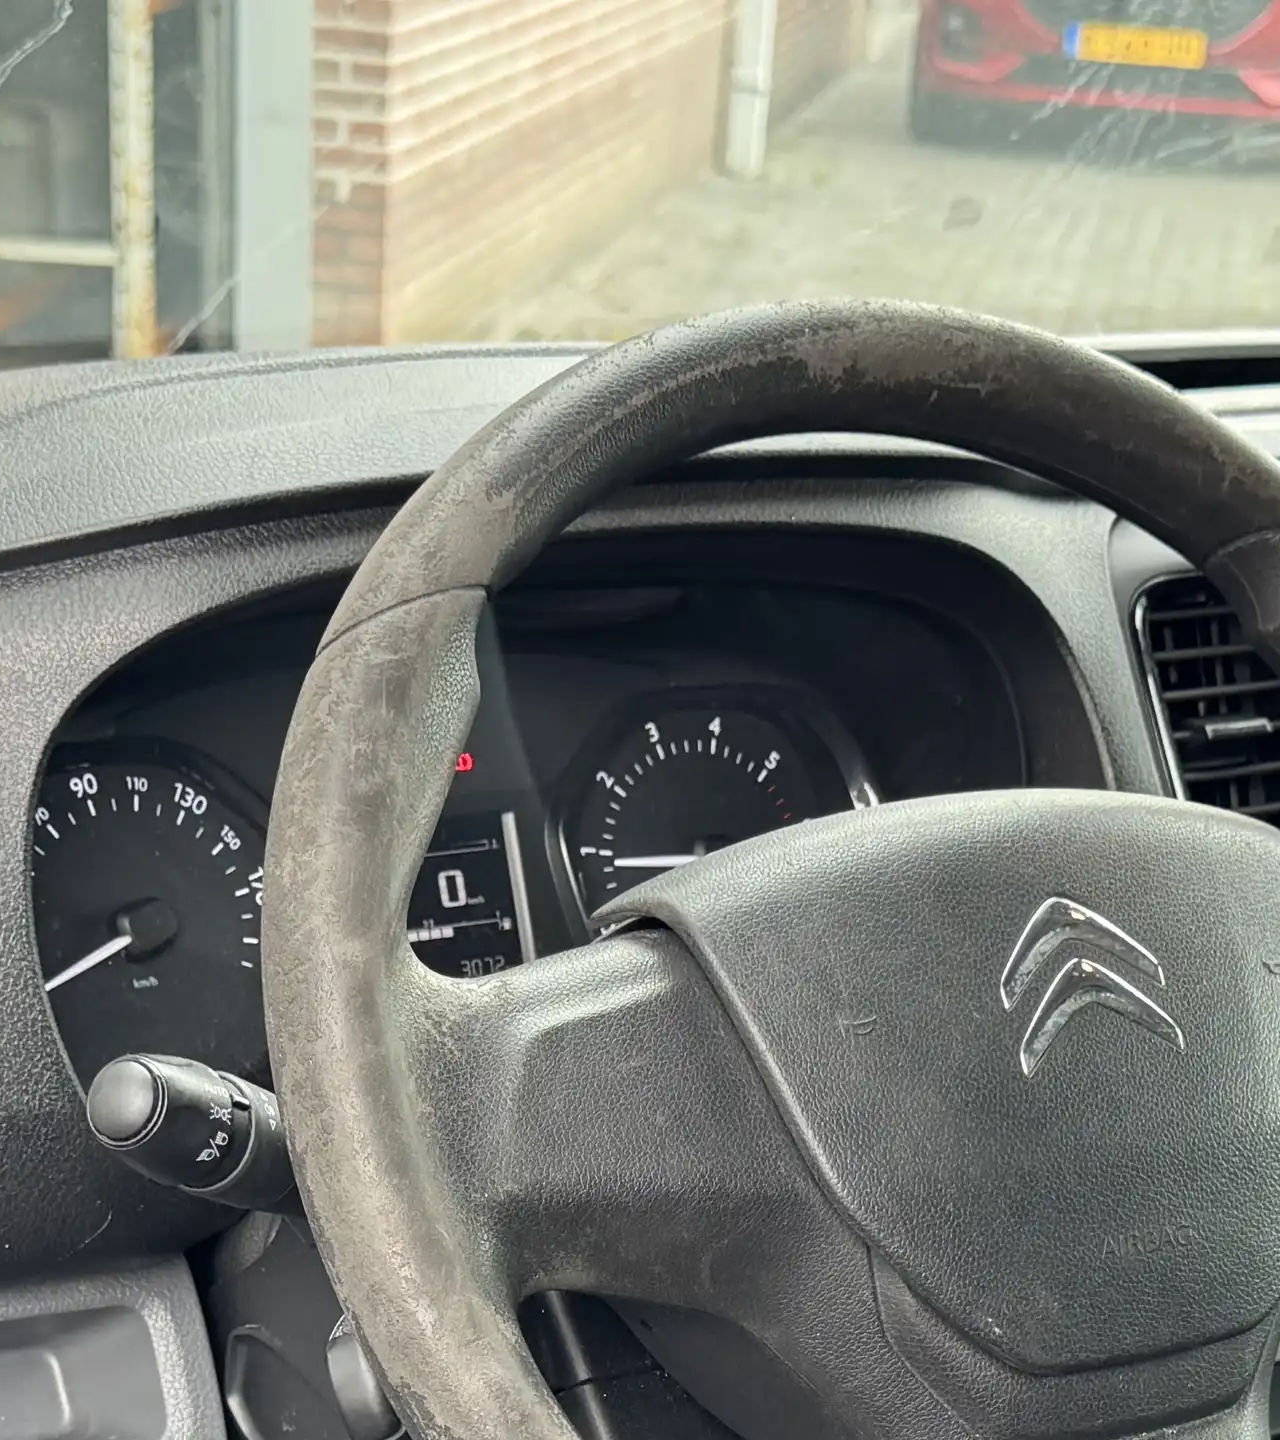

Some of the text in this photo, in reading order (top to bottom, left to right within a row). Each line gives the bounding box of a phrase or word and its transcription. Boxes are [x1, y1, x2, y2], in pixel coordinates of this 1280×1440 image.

[645, 721, 660, 743] 3
[708, 716, 721, 737] 4
[764, 750, 781, 770] 5
[70, 773, 98, 798] 90
[125, 776, 148, 792] 110
[596, 770, 615, 789] 2
[173, 782, 208, 815] 130
[220, 824, 241, 850] 150
[580, 847, 597, 857] 1
[438, 869, 467, 909] 0
[204, 1082, 230, 1098] AUTO
